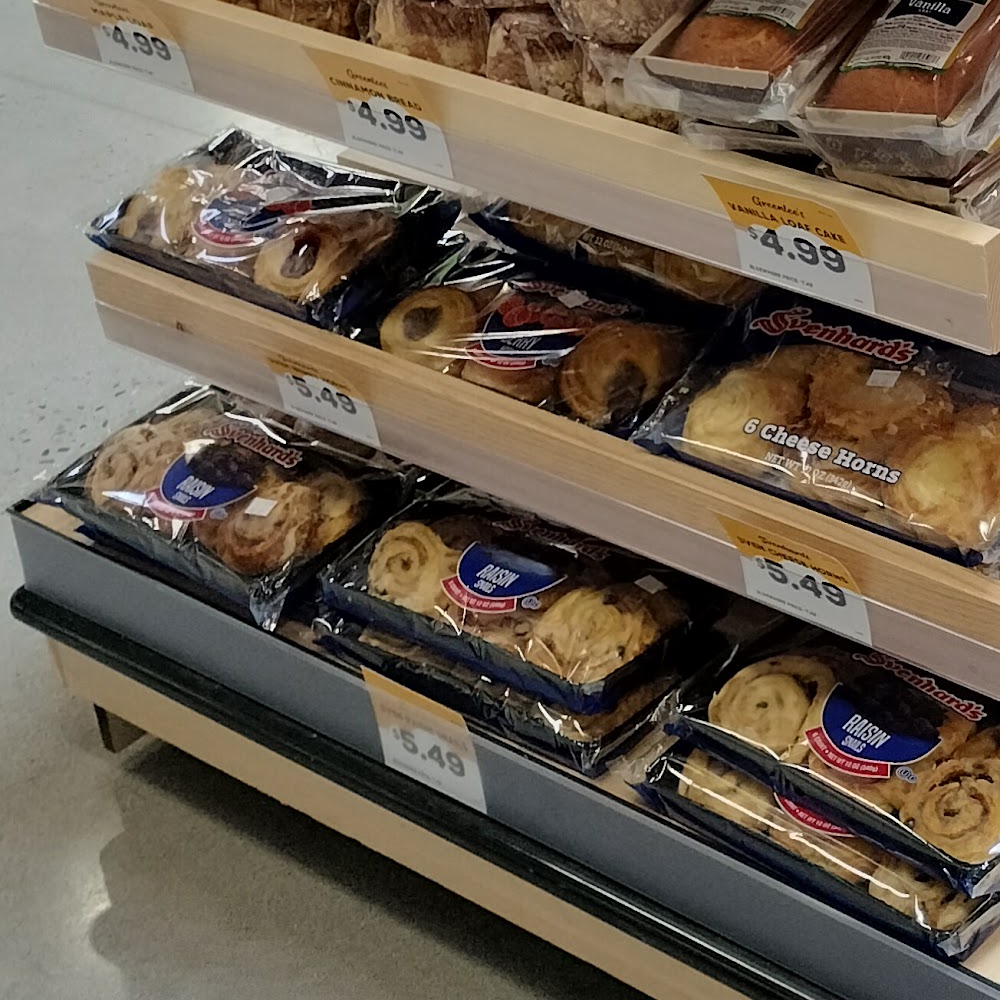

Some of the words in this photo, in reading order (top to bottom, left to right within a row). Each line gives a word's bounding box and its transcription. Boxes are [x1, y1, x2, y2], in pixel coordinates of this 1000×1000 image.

[102, 25, 172, 61] $4.99
[329, 76, 386, 99] CINNAMON
[386, 94, 422, 111] BREAD
[347, 100, 426, 141] $4.99
[727, 201, 779, 223] VANILLA
[780, 217, 811, 233] LOAF
[815, 227, 847, 244] CAKE
[752, 195, 806, 219] Greenlee's
[747, 226, 846, 274] $4.99
[750, 306, 919, 364] Svenhard's
[743, 418, 761, 435] 6
[759, 423, 833, 461] Cheese
[832, 448, 902, 484] Horns
[764, 451, 785, 465] NET
[784, 458, 803, 472] WT
[175, 475, 215, 500] RAISIN
[475, 563, 520, 589] RAISIN
[737, 536, 766, 552] SVEN
[768, 549, 809, 568] CHEESE
[810, 564, 849, 584] HORNS
[755, 557, 847, 607] $5.49
[852, 651, 988, 722] Svenhard's
[841, 713, 891, 749] RAISIN
